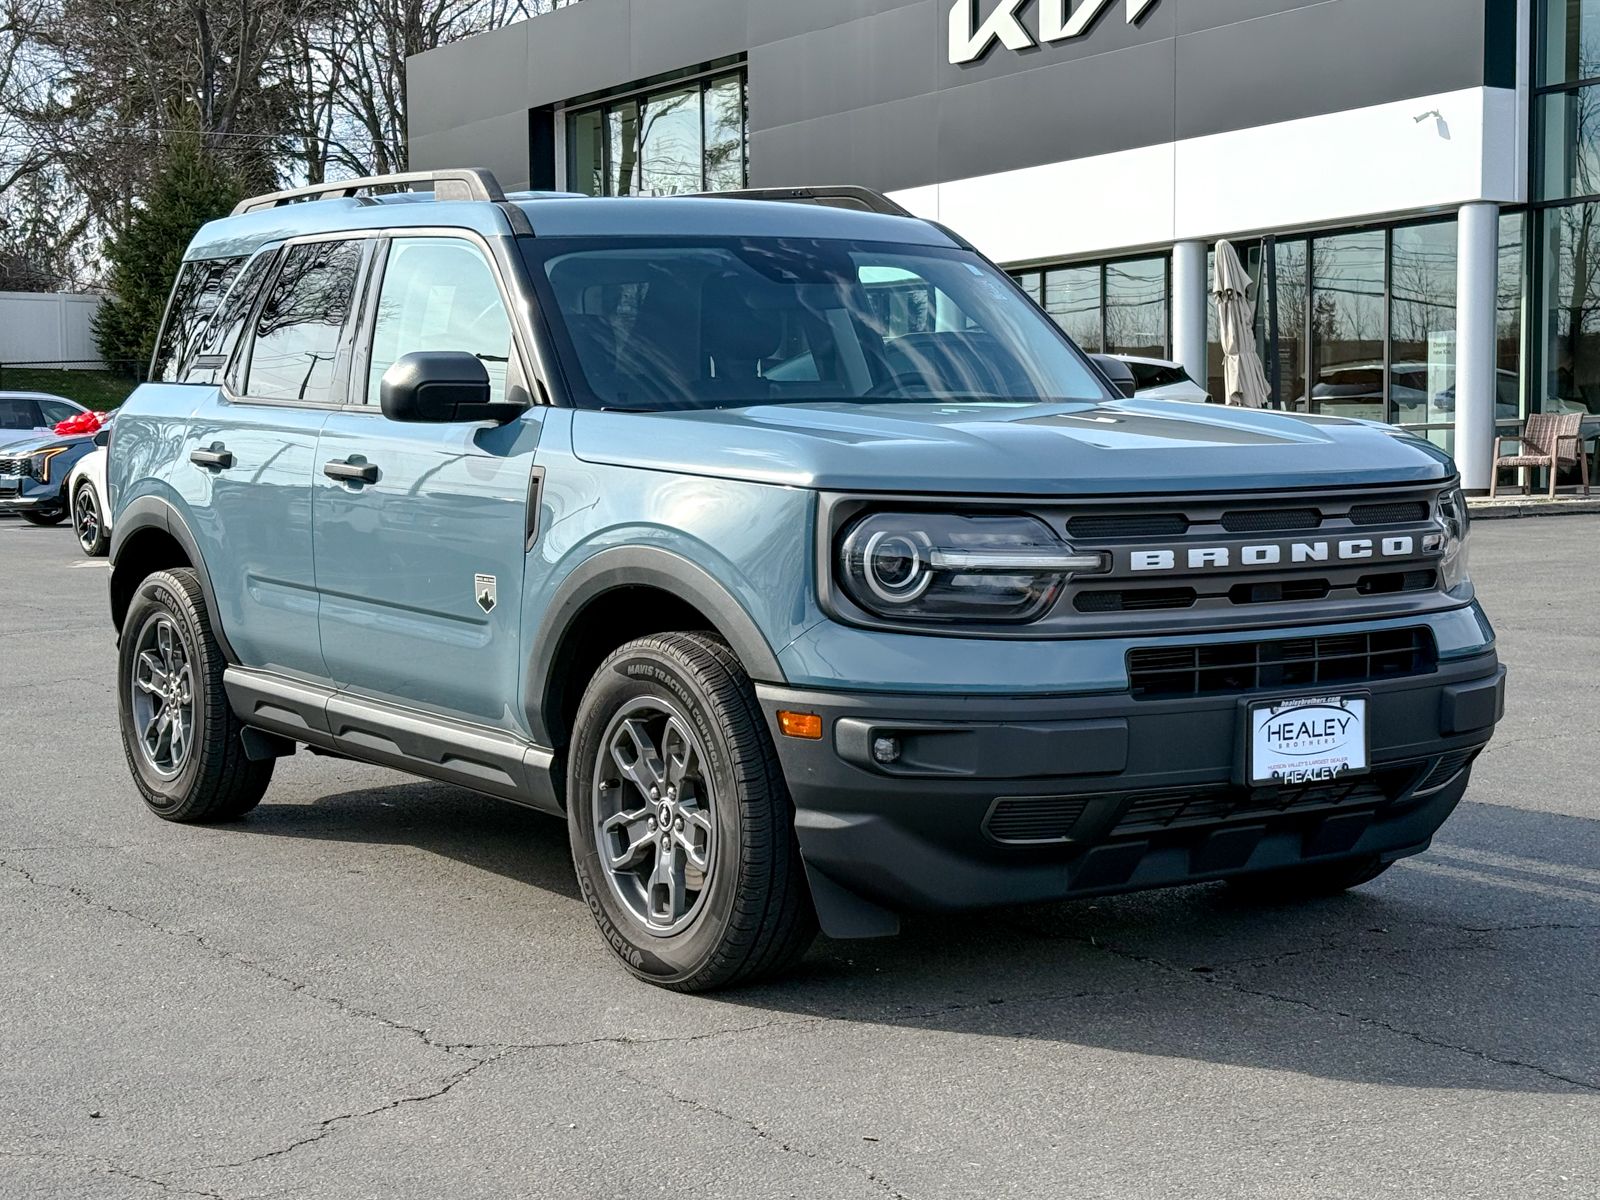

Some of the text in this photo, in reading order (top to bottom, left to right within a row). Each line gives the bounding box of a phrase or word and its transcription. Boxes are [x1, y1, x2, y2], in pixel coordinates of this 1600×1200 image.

[1130, 536, 1413, 571] BRONCO
[627, 664, 721, 772] MAVIS TRACTION CONTROL
[1267, 717, 1351, 742] HEALEY
[1278, 738, 1336, 749] BROTHERS
[1283, 765, 1339, 785] HEALEY
